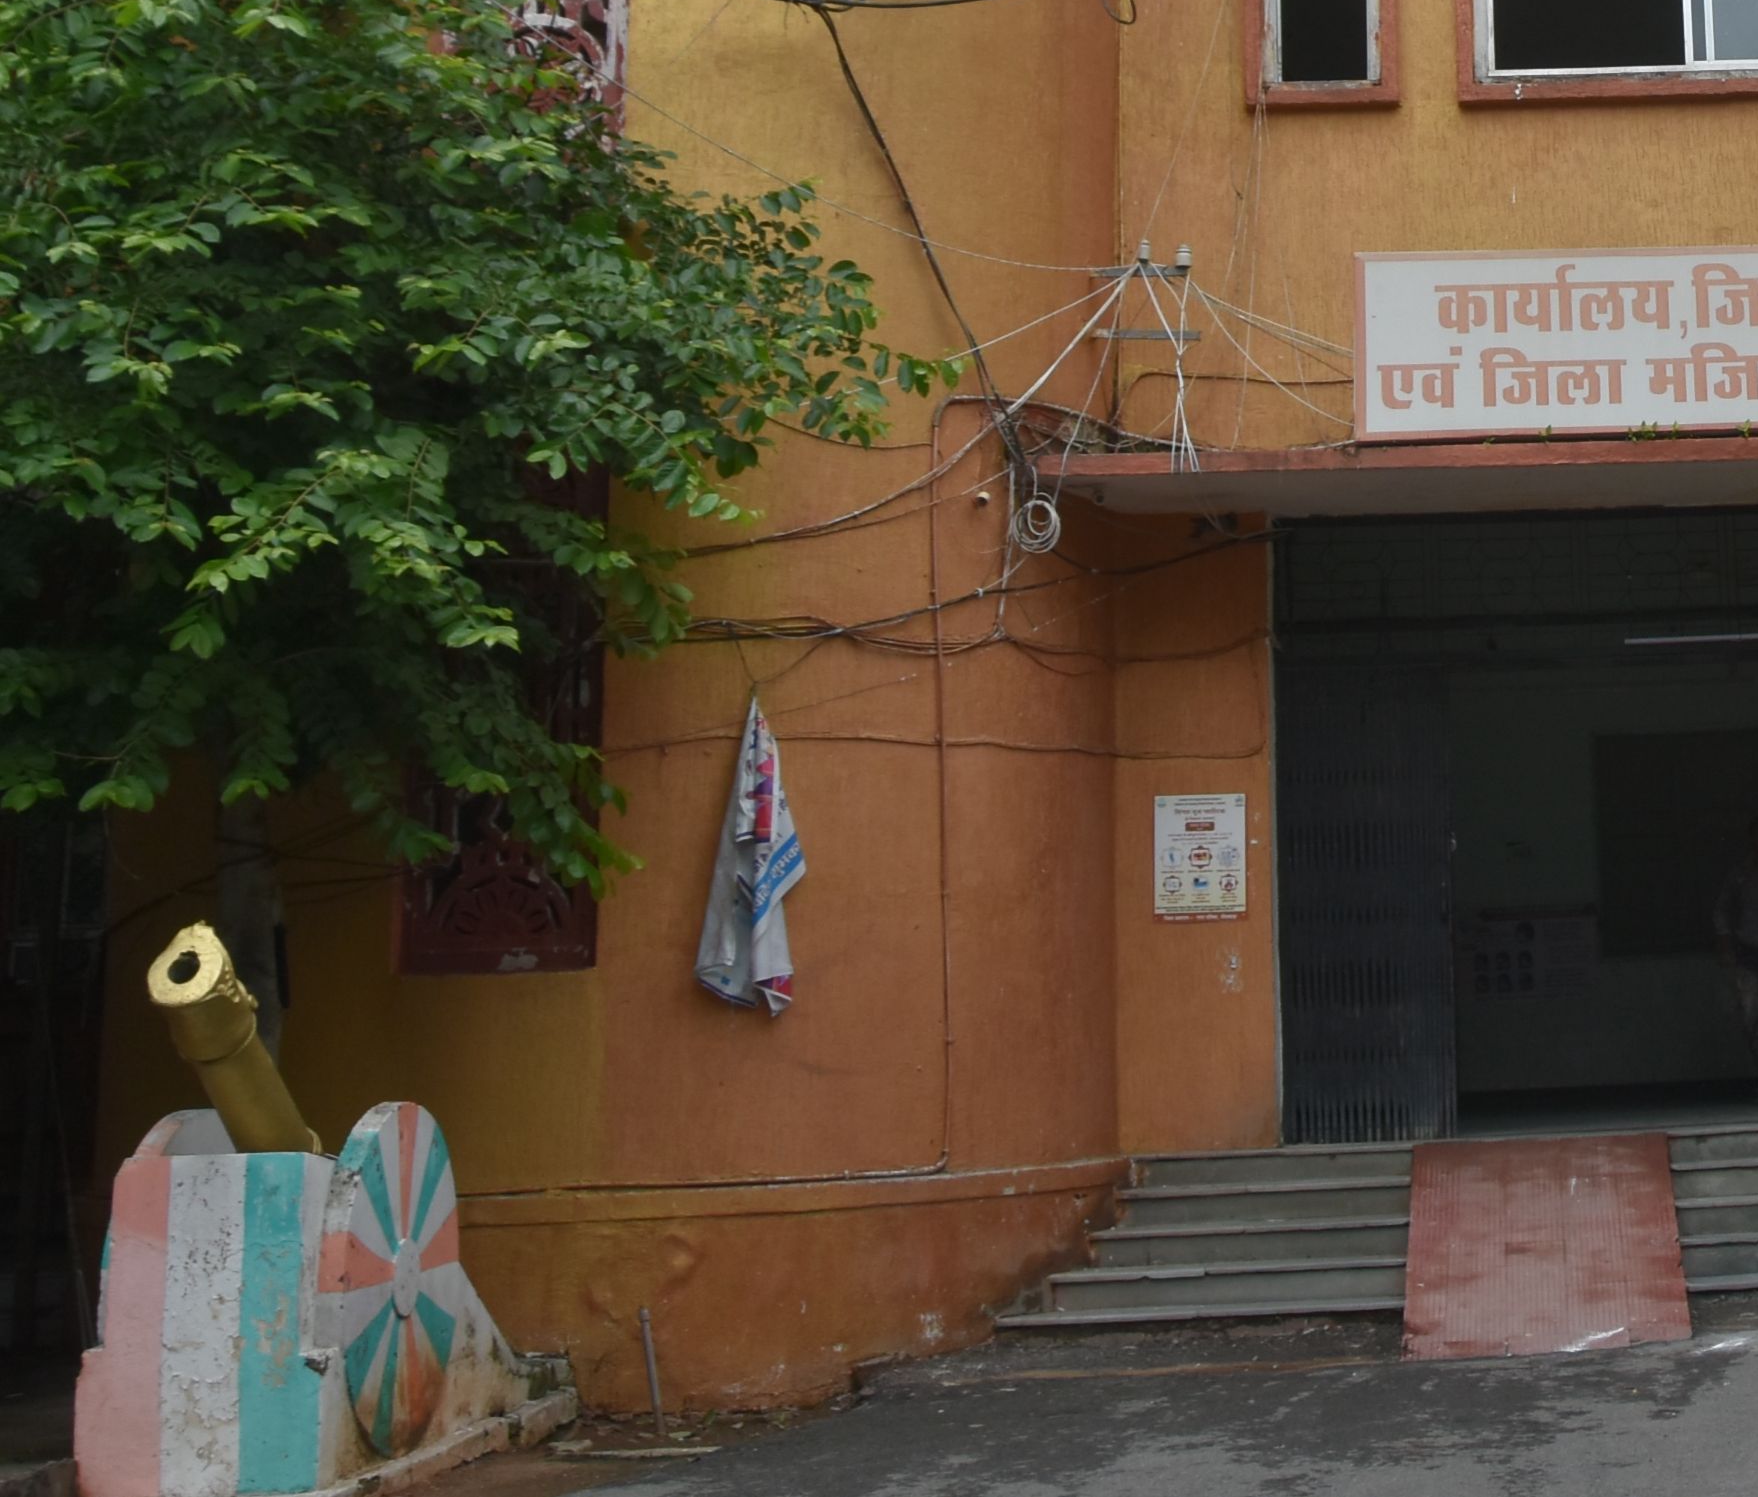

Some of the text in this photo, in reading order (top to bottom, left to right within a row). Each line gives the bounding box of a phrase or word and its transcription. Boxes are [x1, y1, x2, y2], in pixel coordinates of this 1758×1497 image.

[1432, 259, 1687, 339] कार्यालय,
[1377, 346, 1461, 409] एवं
[1479, 347, 1627, 407] जिला
